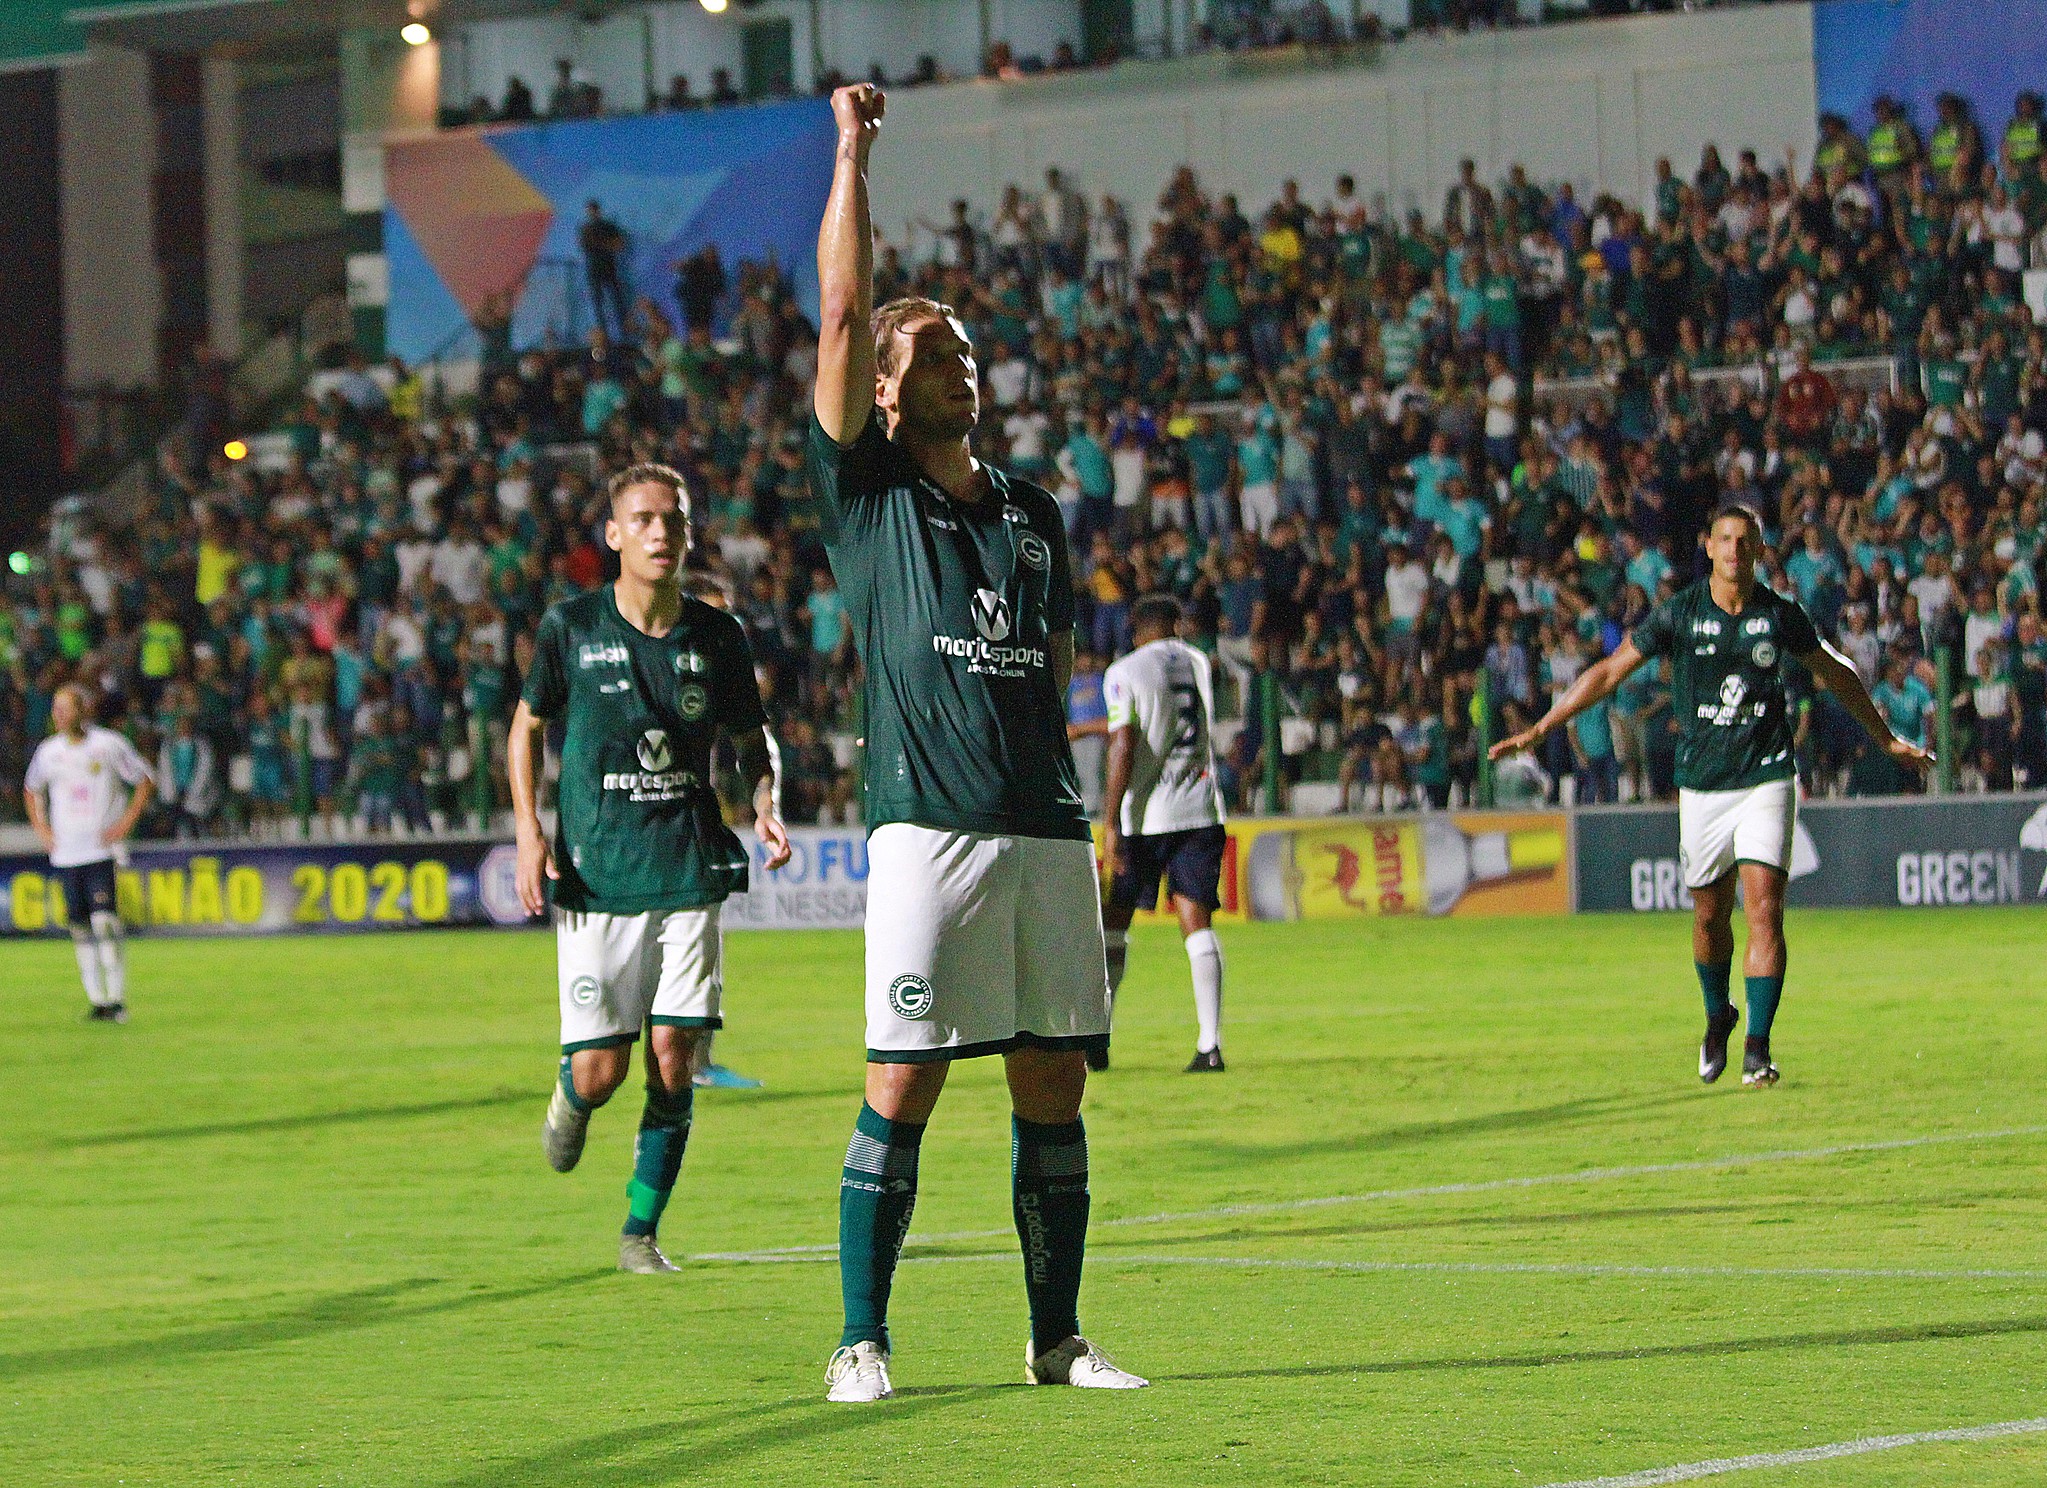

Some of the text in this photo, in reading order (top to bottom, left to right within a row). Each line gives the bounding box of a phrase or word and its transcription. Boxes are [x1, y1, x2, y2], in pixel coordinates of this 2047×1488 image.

[10, 857, 263, 930] GANÃO
[291, 861, 447, 923] 2020
[1897, 851, 2021, 906] GREEN
[841, 1177, 886, 1194] GREEN
